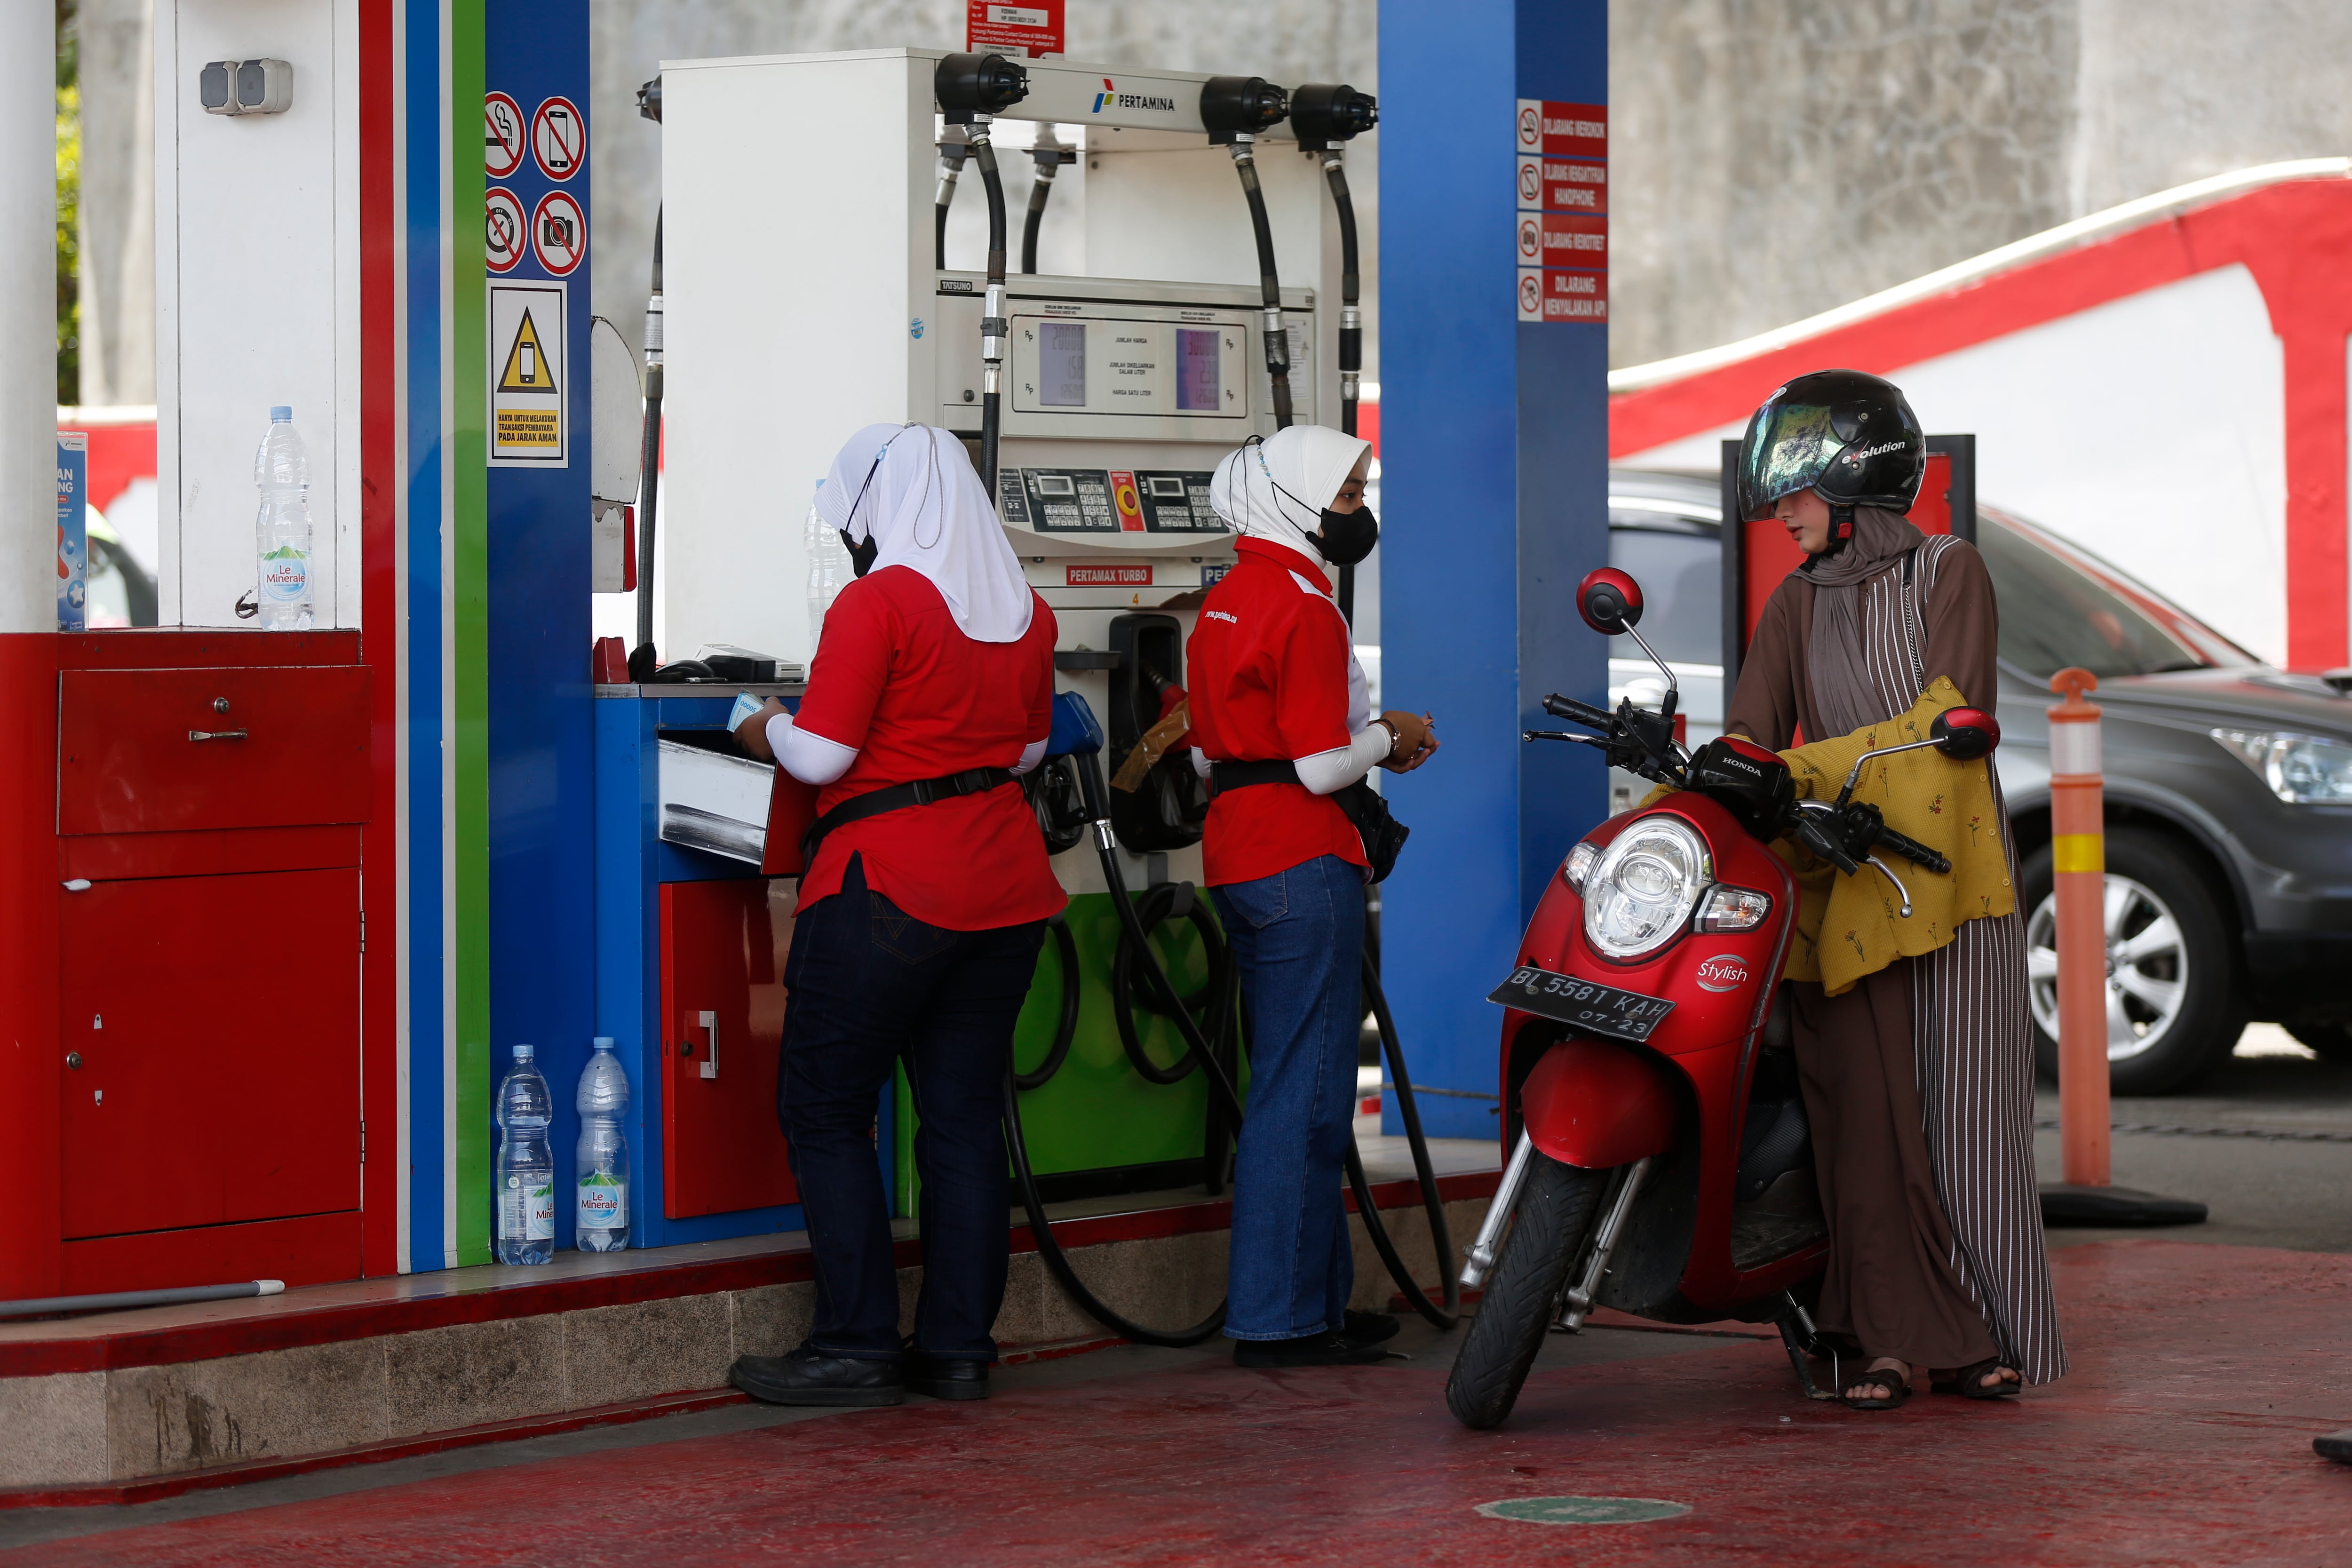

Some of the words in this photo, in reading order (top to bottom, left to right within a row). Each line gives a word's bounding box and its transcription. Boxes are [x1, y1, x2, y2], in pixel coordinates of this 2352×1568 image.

[1119, 94, 1175, 111] PERTAMINA
[1543, 118, 1574, 136] DILARANG
[1554, 187, 1596, 207] HANDPHONE
[1544, 231, 1573, 249] DILARANG
[942, 281, 971, 290] TATSUNO
[1555, 275, 1596, 293] DILARANG
[1025, 330, 1033, 342] Rp
[1226, 339, 1233, 350] Rp
[1025, 383, 1033, 395] Rp
[1226, 390, 1234, 401] Rp
[499, 432, 515, 441] PADA
[516, 433, 537, 442] JARAK
[538, 433, 557, 442] AMAN
[279, 565, 291, 574] Le
[1070, 569, 1116, 582] PERTAMAX
[1118, 569, 1147, 581] TURBO
[267, 573, 305, 583] Minerale
[1132, 593, 1139, 605] 4
[740, 700, 757, 713] 50000
[1722, 757, 1762, 777] HONDA
[1698, 963, 1747, 981] Stylish
[1510, 971, 1541, 988] BL
[1544, 977, 1608, 1004] 5581
[1613, 995, 1668, 1017] KAH
[593, 1192, 603, 1201] Le
[547, 1201, 553, 1210] Le
[581, 1200, 617, 1209] Minerale
